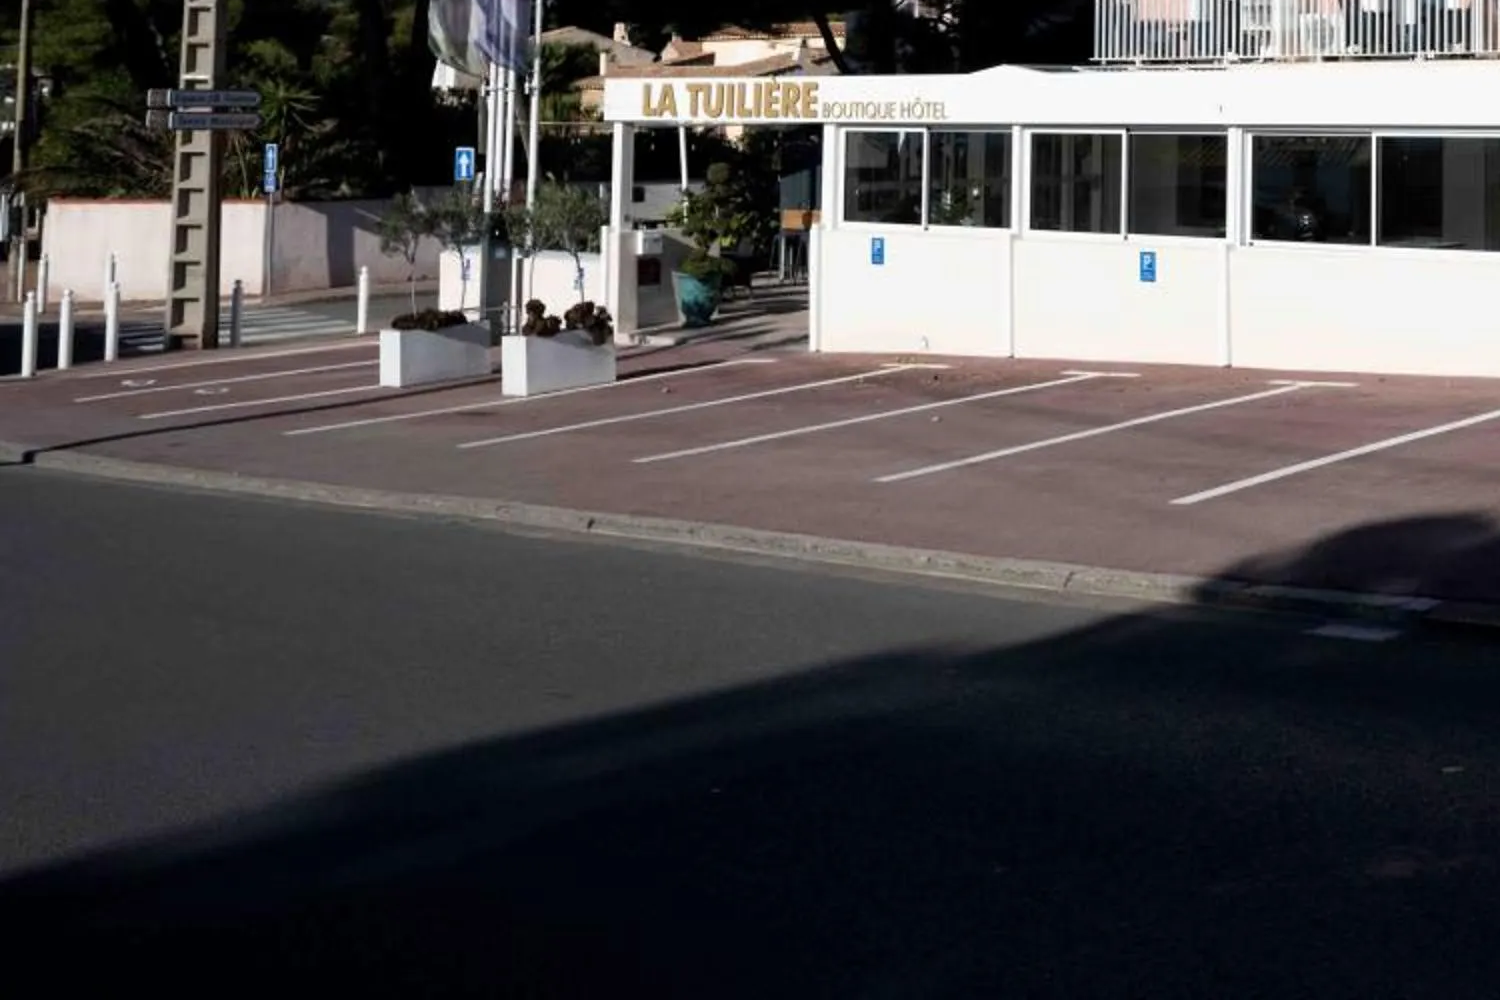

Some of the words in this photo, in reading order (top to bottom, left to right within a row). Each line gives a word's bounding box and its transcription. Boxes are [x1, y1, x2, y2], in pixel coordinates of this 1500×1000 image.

[643, 83, 677, 117] LA
[686, 76, 818, 118] TUILIÈRE
[822, 102, 897, 119] BOUTIQUE
[901, 98, 949, 119] HÔTEL
